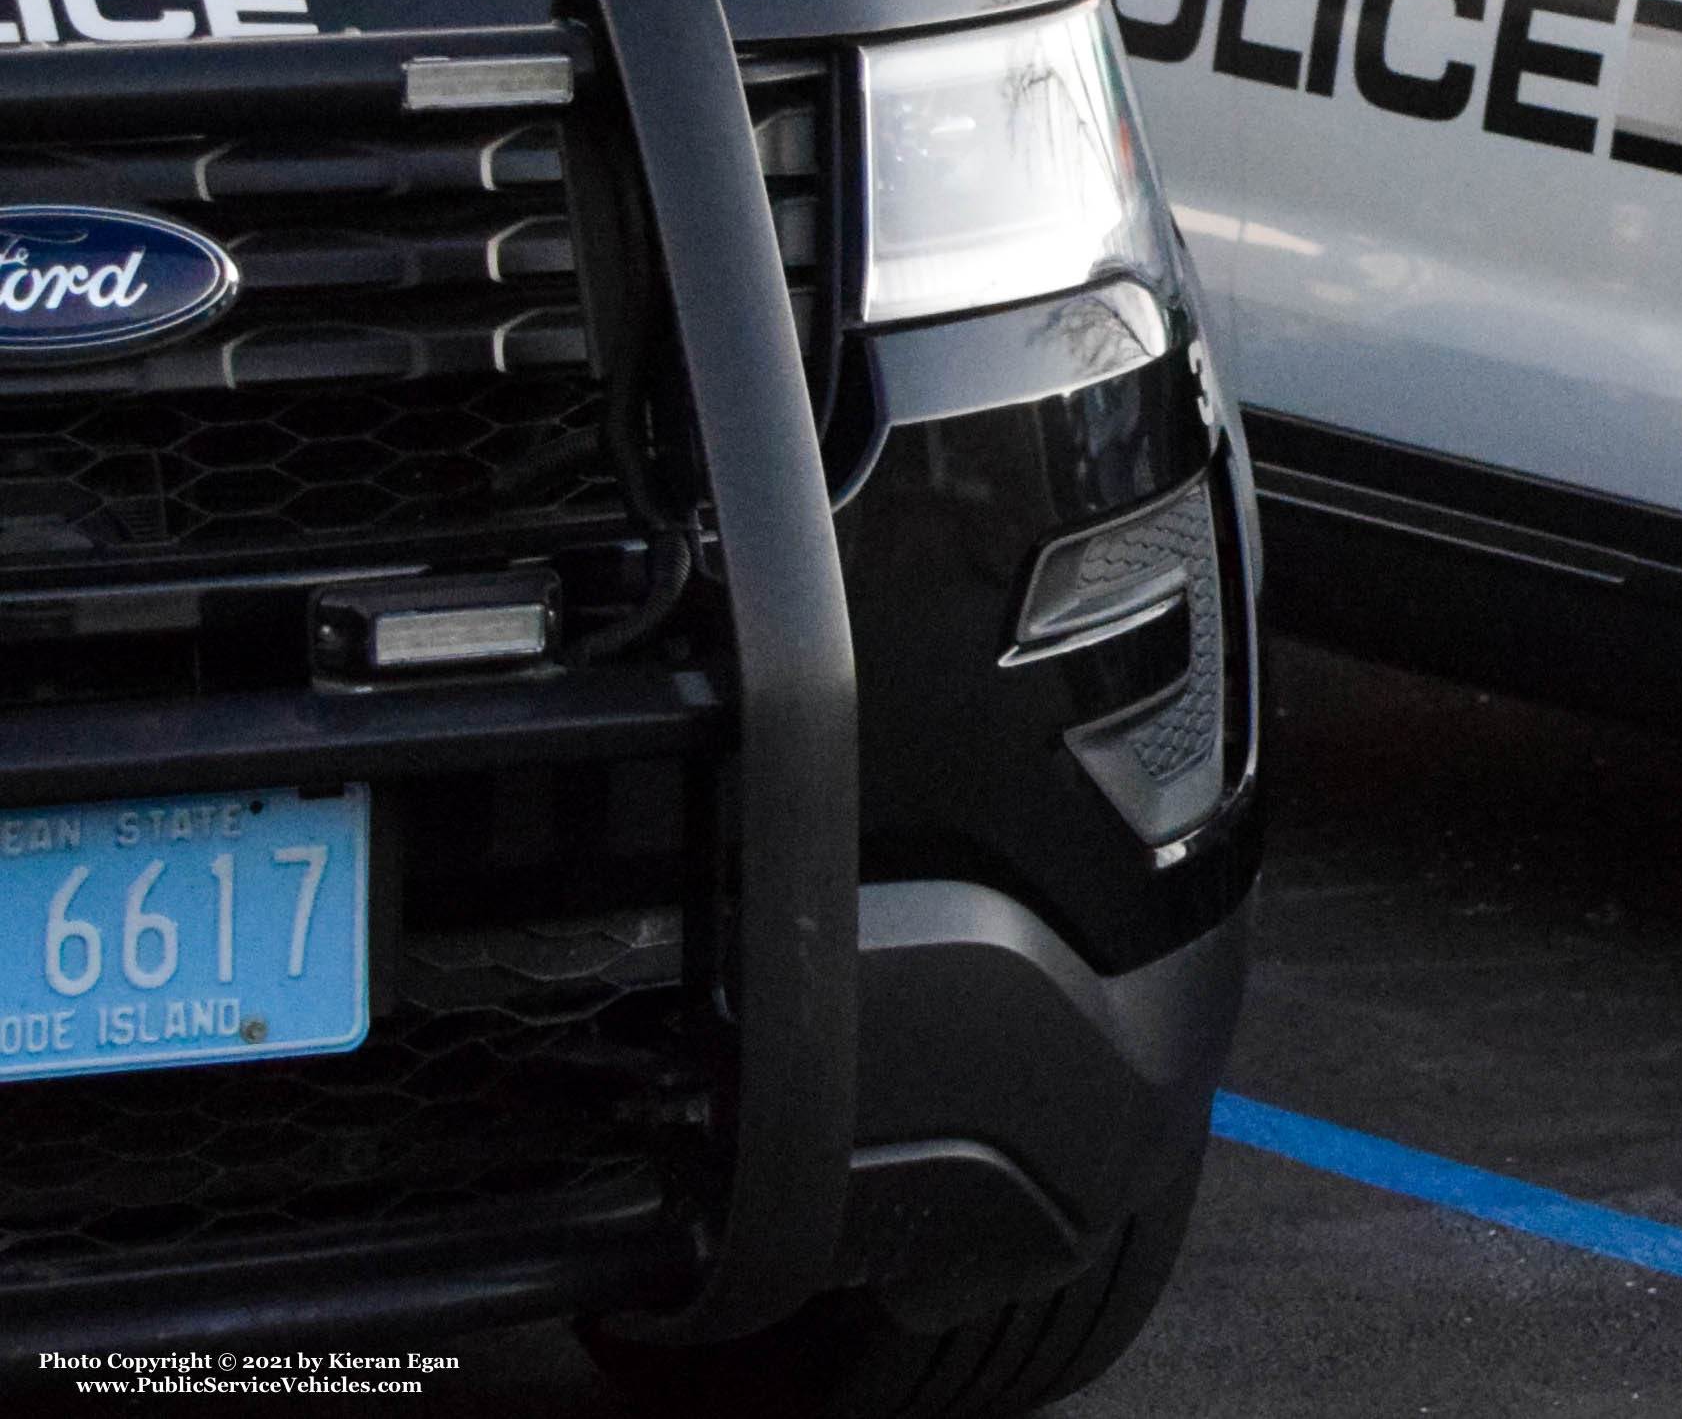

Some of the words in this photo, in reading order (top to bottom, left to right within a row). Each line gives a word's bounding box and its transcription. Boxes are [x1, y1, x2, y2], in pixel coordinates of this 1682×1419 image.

[0, 248, 148, 312] ord
[114, 804, 243, 846] STATE
[45, 843, 328, 996] 6617
[99, 997, 241, 1045] ISLAND
